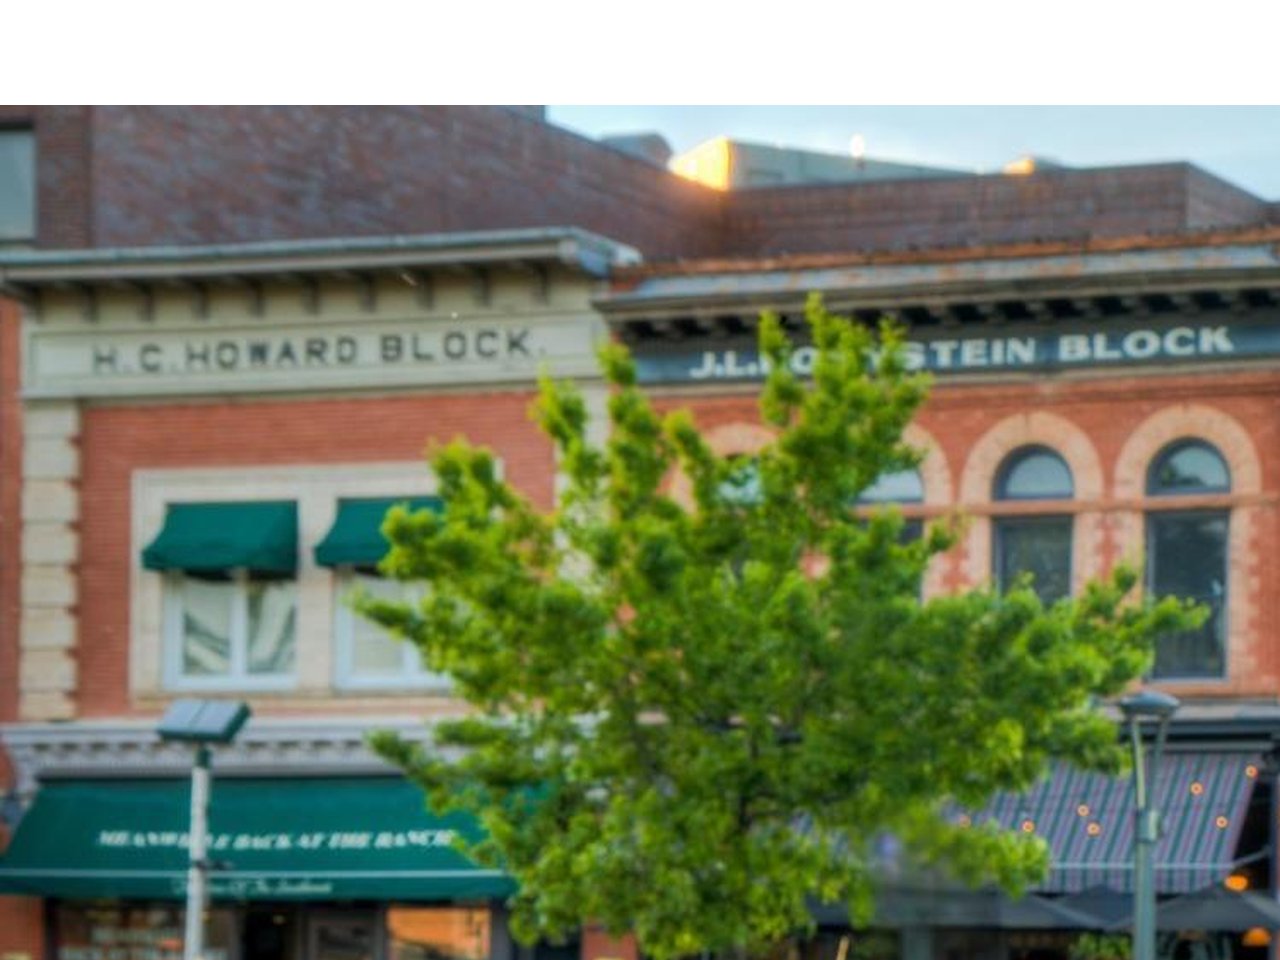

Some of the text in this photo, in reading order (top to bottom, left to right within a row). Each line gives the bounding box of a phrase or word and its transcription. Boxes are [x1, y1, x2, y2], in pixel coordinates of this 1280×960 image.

[1058, 325, 1235, 363] BLOCK
[232, 832, 293, 850] BACK
[297, 831, 327, 850] AT
[328, 831, 374, 850] THE
